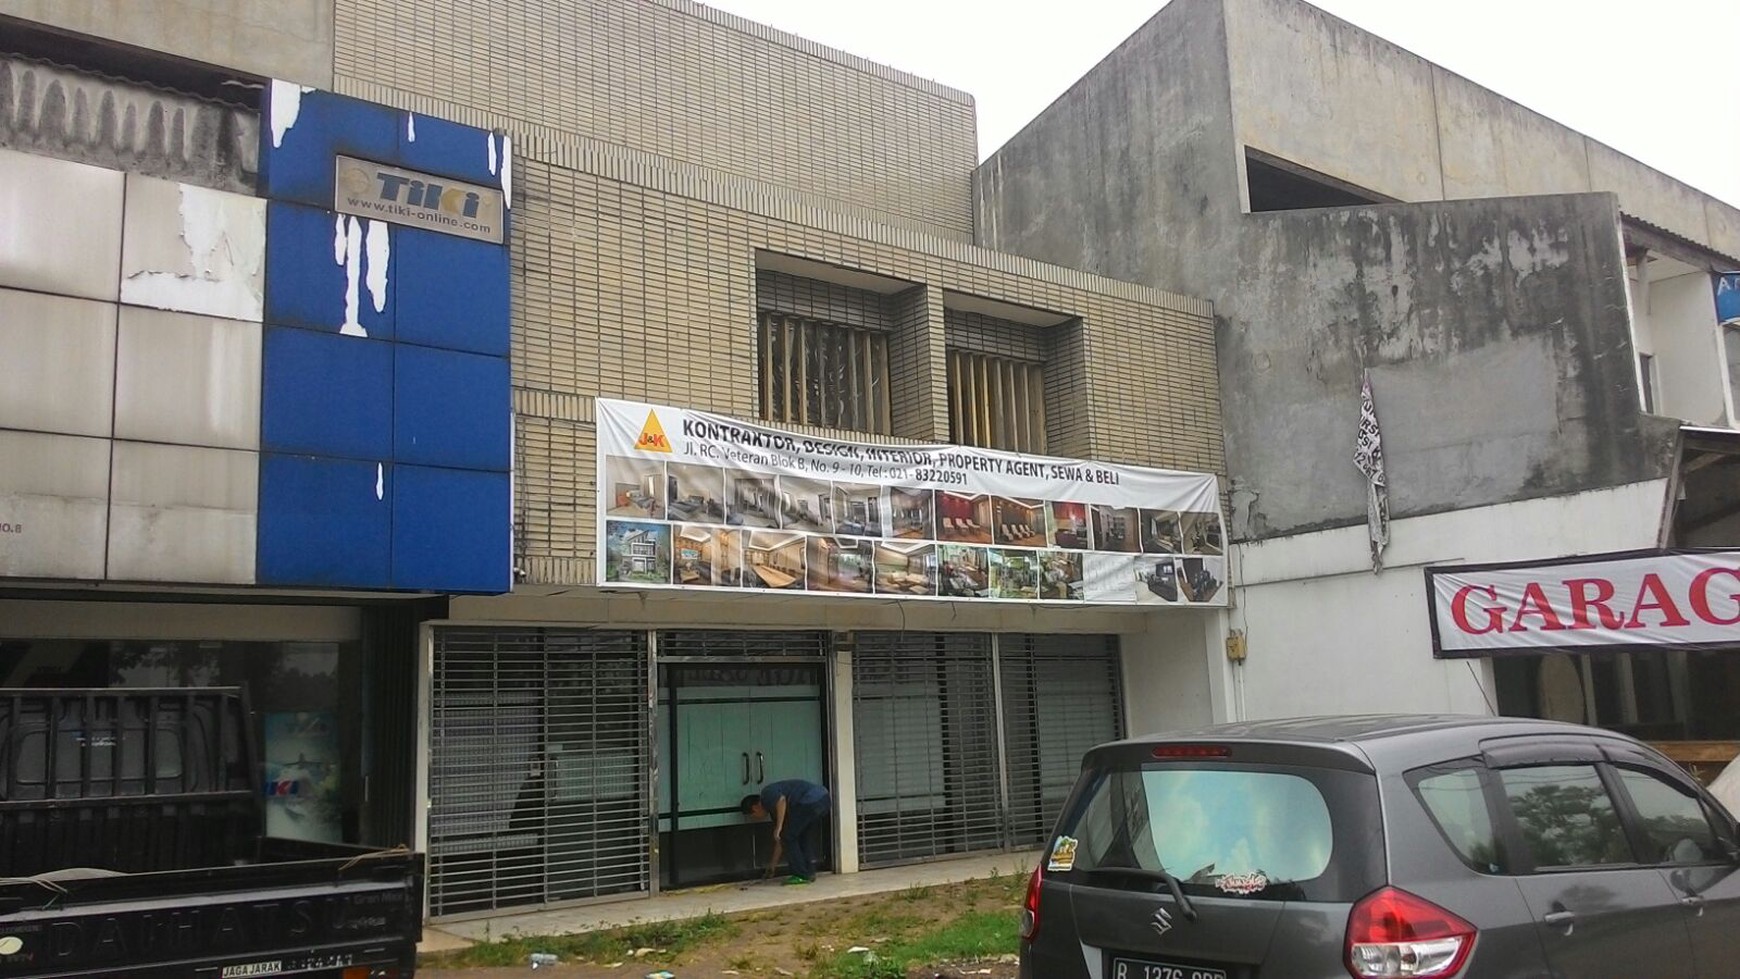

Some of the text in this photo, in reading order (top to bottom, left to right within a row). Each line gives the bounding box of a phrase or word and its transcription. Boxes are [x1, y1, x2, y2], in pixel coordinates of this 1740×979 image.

[347, 197, 491, 234] www.tiki-online.com
[638, 432, 666, 448] J&K
[683, 418, 1120, 486] KONTRAKTOR, DESIGN, INTERIOR, PROPERTY AGENT, SEWA & BELI
[700, 444, 720, 460] RC.
[721, 446, 769, 466] Veteran
[770, 453, 796, 469] Blok
[797, 457, 809, 473] B,
[810, 459, 830, 473] No.
[832, 461, 841, 474] 9
[849, 463, 864, 478] 10,
[1450, 566, 1740, 636] GARAG
[47, 896, 353, 958] DAIHATSU
[223, 965, 249, 978] JAGA
[249, 961, 281, 974] JARAK
